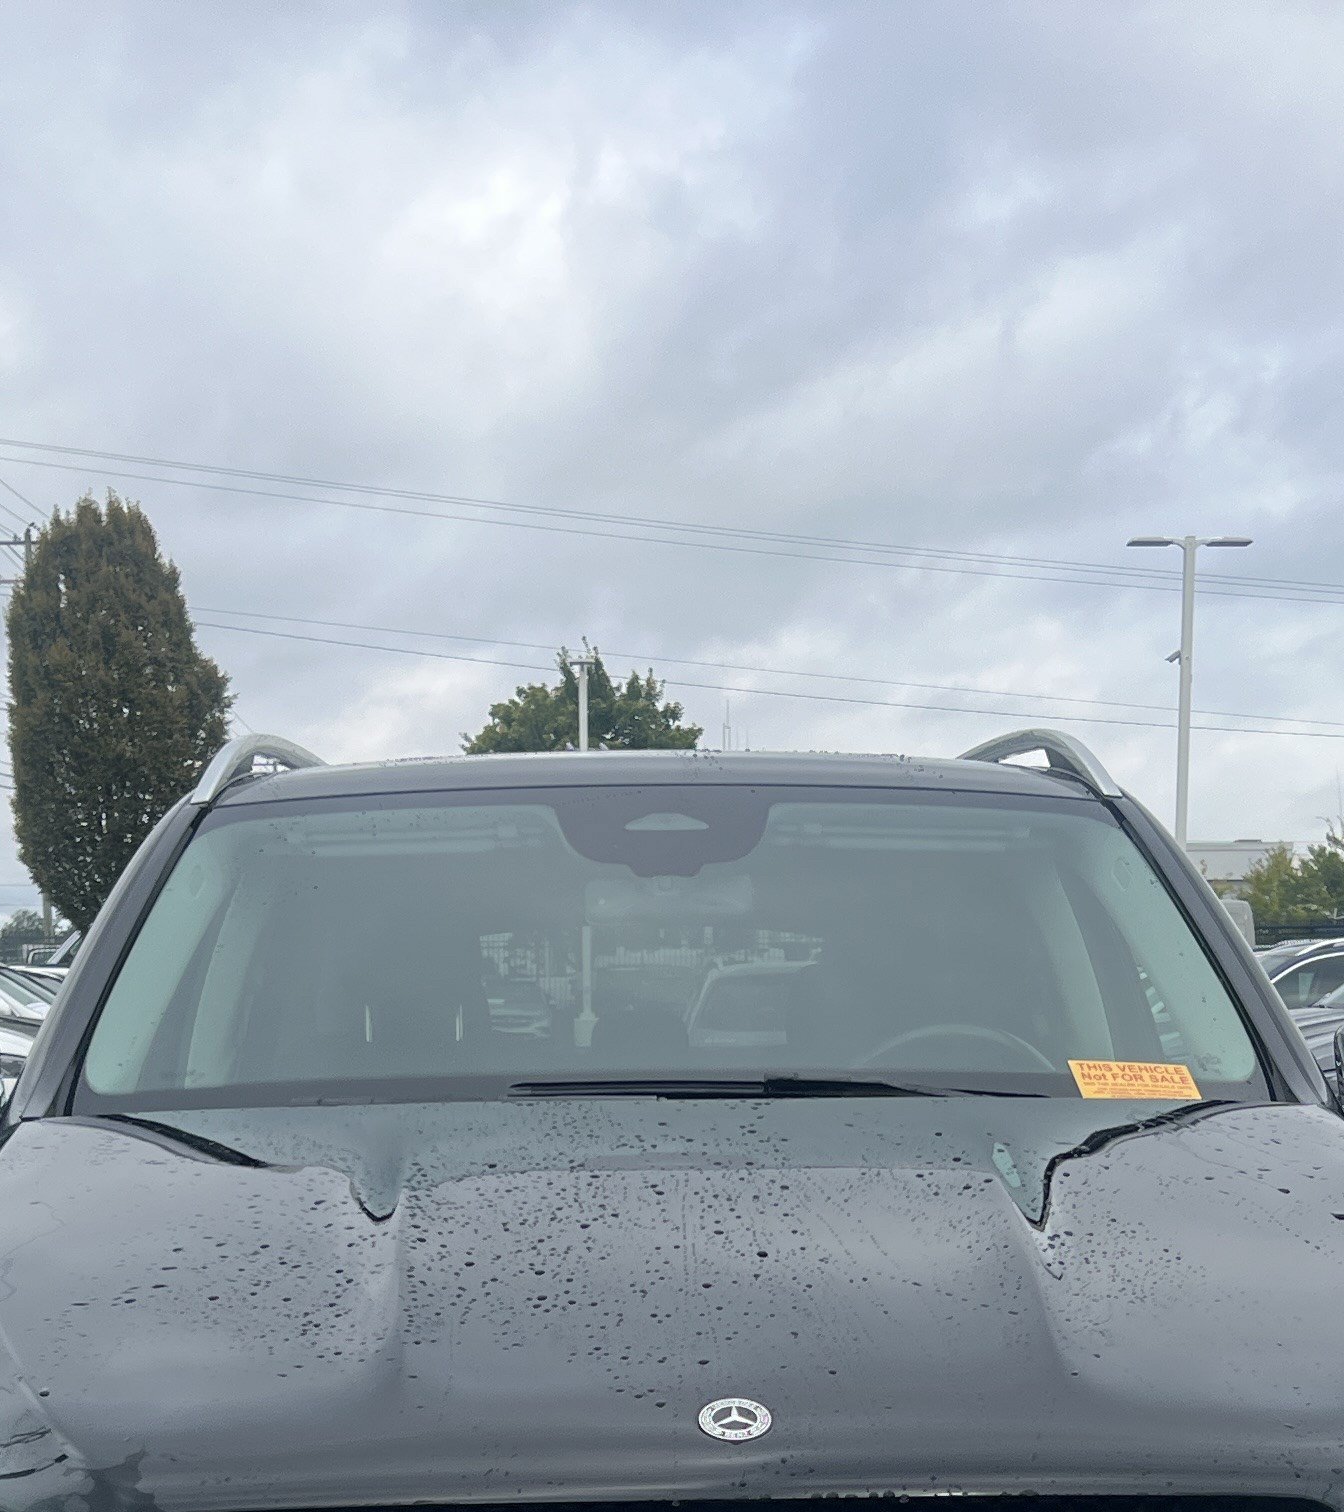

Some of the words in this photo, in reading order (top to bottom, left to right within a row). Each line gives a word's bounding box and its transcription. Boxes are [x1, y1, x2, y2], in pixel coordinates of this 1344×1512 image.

[1076, 1062, 1113, 1073] THIS
[1115, 1063, 1186, 1077] VEHICLE
[1081, 1072, 1109, 1082] Not
[1110, 1072, 1146, 1083] FOR
[1149, 1074, 1191, 1086] SALE
